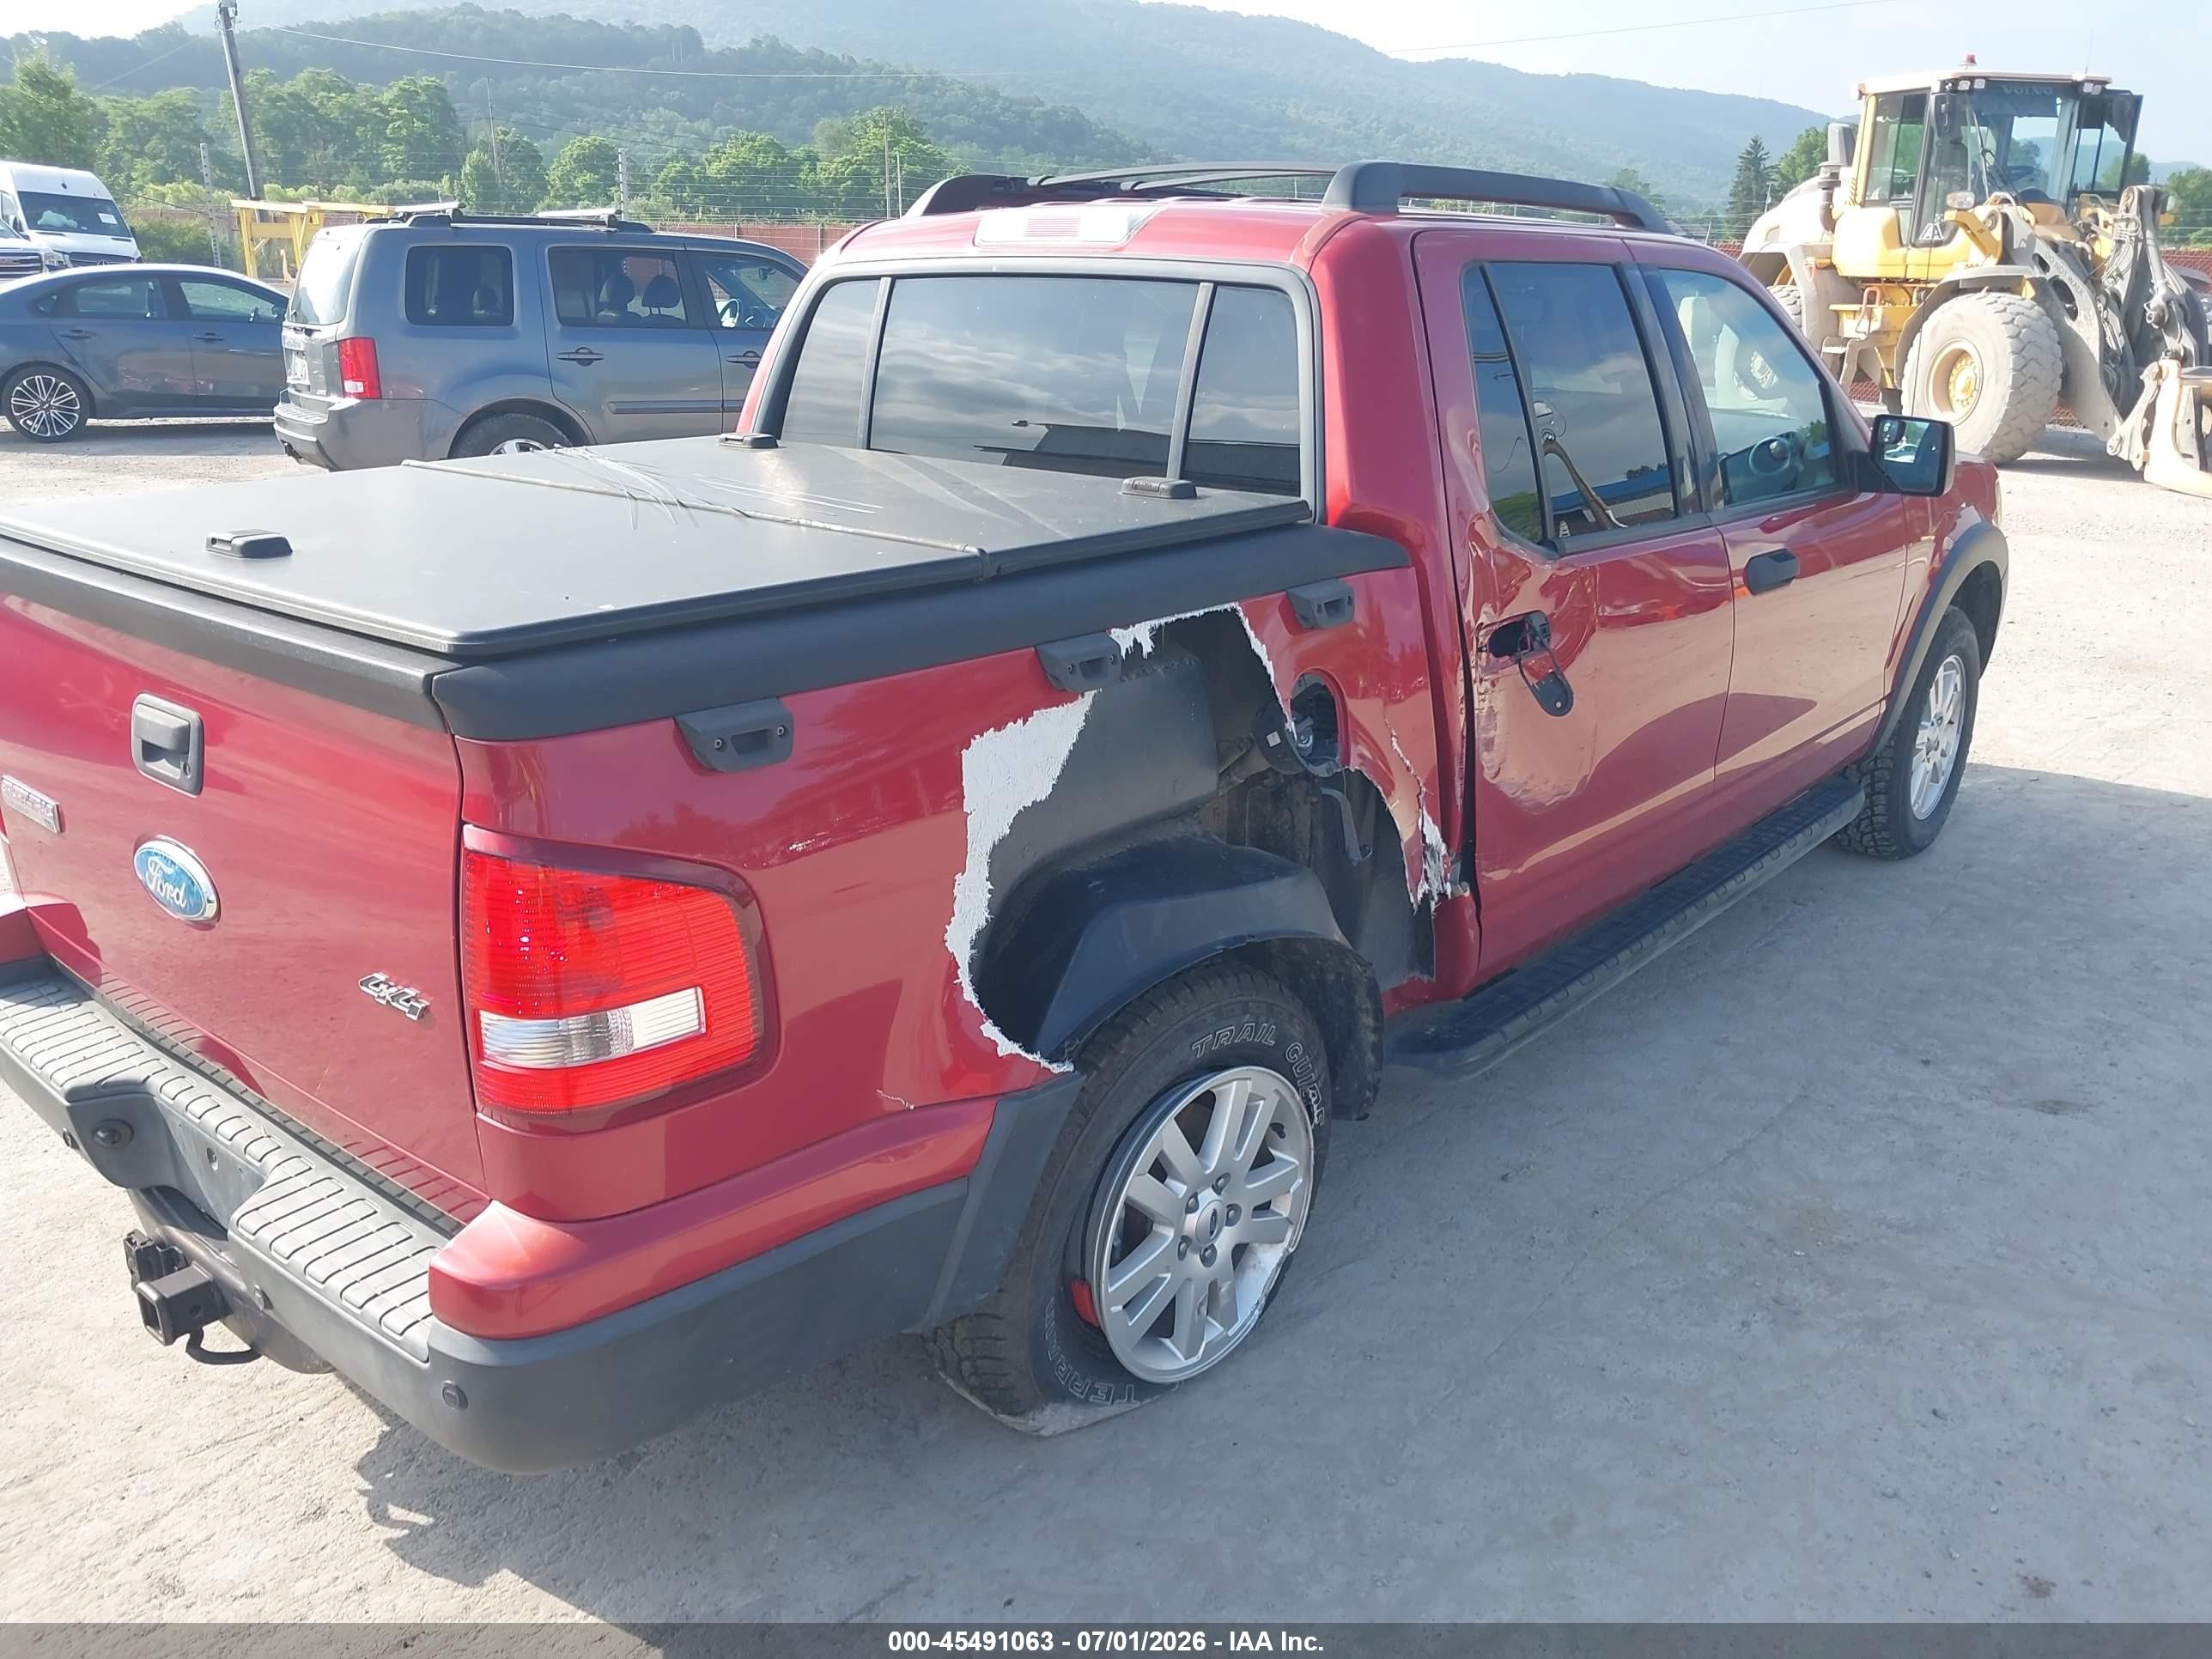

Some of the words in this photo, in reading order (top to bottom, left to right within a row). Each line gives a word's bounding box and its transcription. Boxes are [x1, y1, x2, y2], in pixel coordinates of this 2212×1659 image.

[2002, 86, 2053, 96] VOLVO
[145, 855, 187, 908] Ford
[1191, 1022, 1276, 1059] TRAIL
